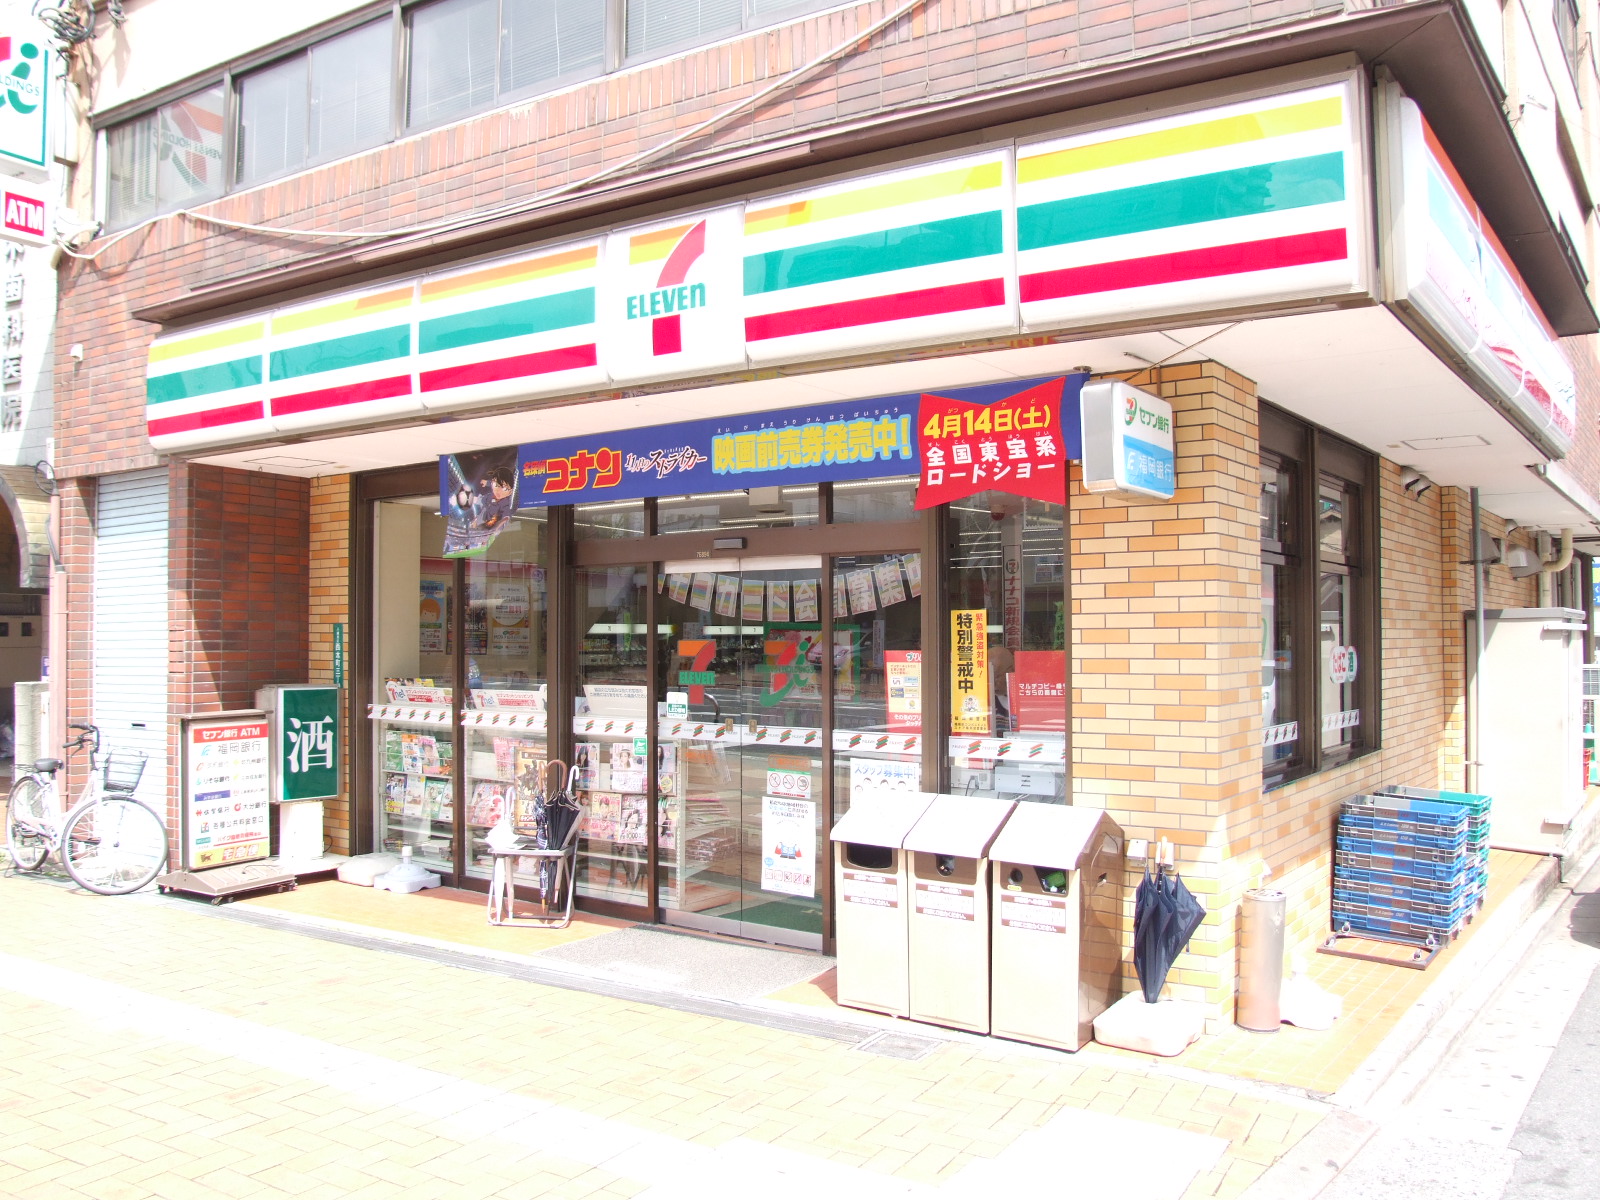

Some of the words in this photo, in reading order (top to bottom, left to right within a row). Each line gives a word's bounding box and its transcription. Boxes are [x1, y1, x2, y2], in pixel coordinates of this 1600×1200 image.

[6, 198, 43, 232] ATM
[923, 404, 1051, 439] 4月14日(土)
[1139, 406, 1170, 434] セブン銀行
[713, 416, 912, 472] 映画前売券発売中!
[926, 435, 1057, 467] 全国東宝系
[927, 462, 1056, 486] ロードショー
[1139, 453, 1172, 482] 福岡銀行
[956, 612, 974, 694] 特別警戒中
[202, 728, 239, 740] セブン銀行
[240, 726, 260, 738] ATM
[218, 740, 261, 755] 福岡銀行
[286, 715, 334, 774] 酒
[854, 763, 916, 780] スタッフ募集中!
